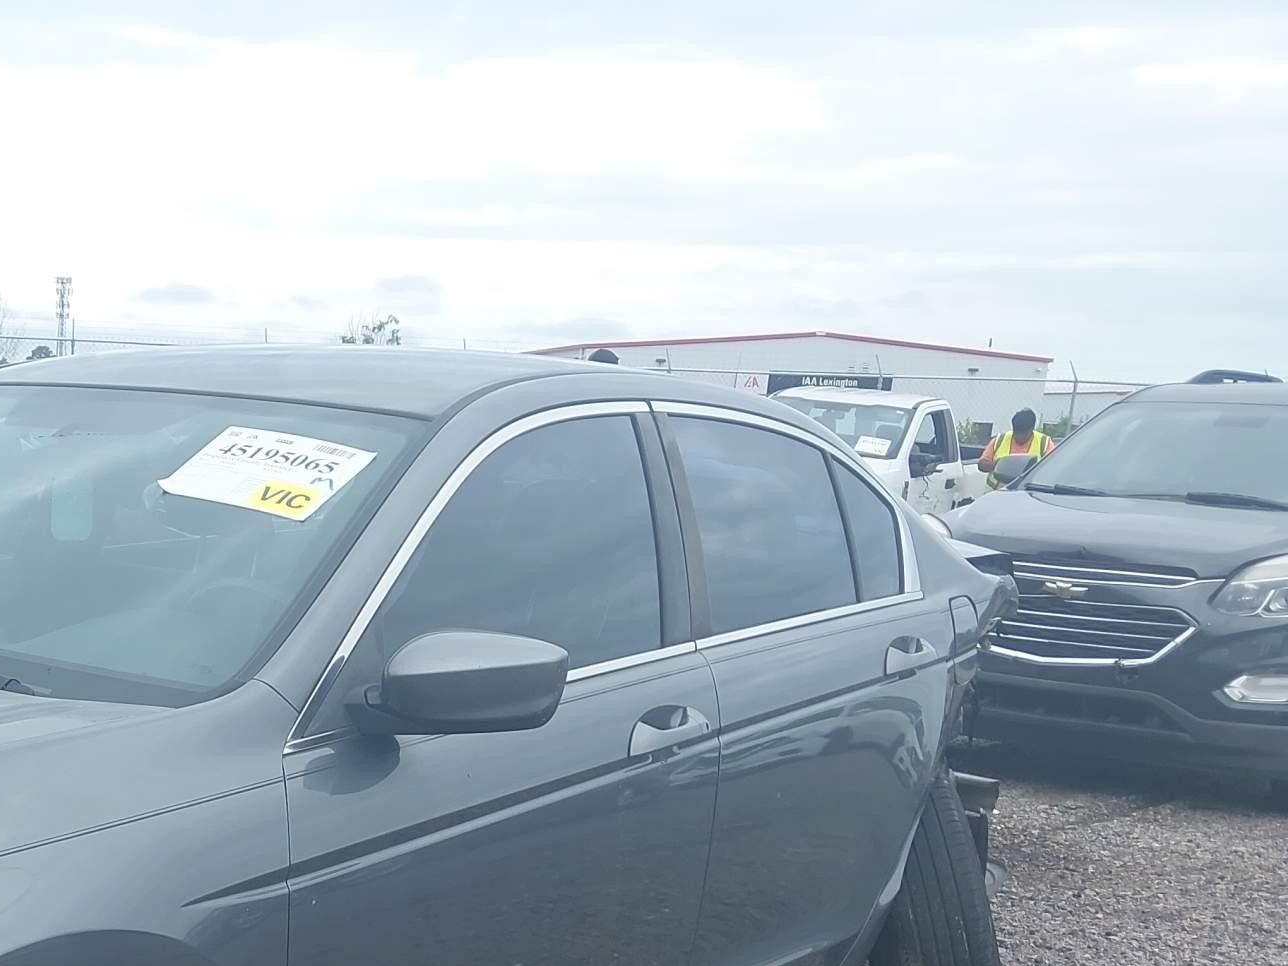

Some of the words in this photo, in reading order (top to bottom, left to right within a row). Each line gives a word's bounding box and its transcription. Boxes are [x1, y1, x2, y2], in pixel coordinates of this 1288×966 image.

[802, 376, 817, 386] IAA
[819, 377, 858, 389] Lexington
[218, 443, 340, 474] 45195065
[259, 486, 311, 509] VIC
